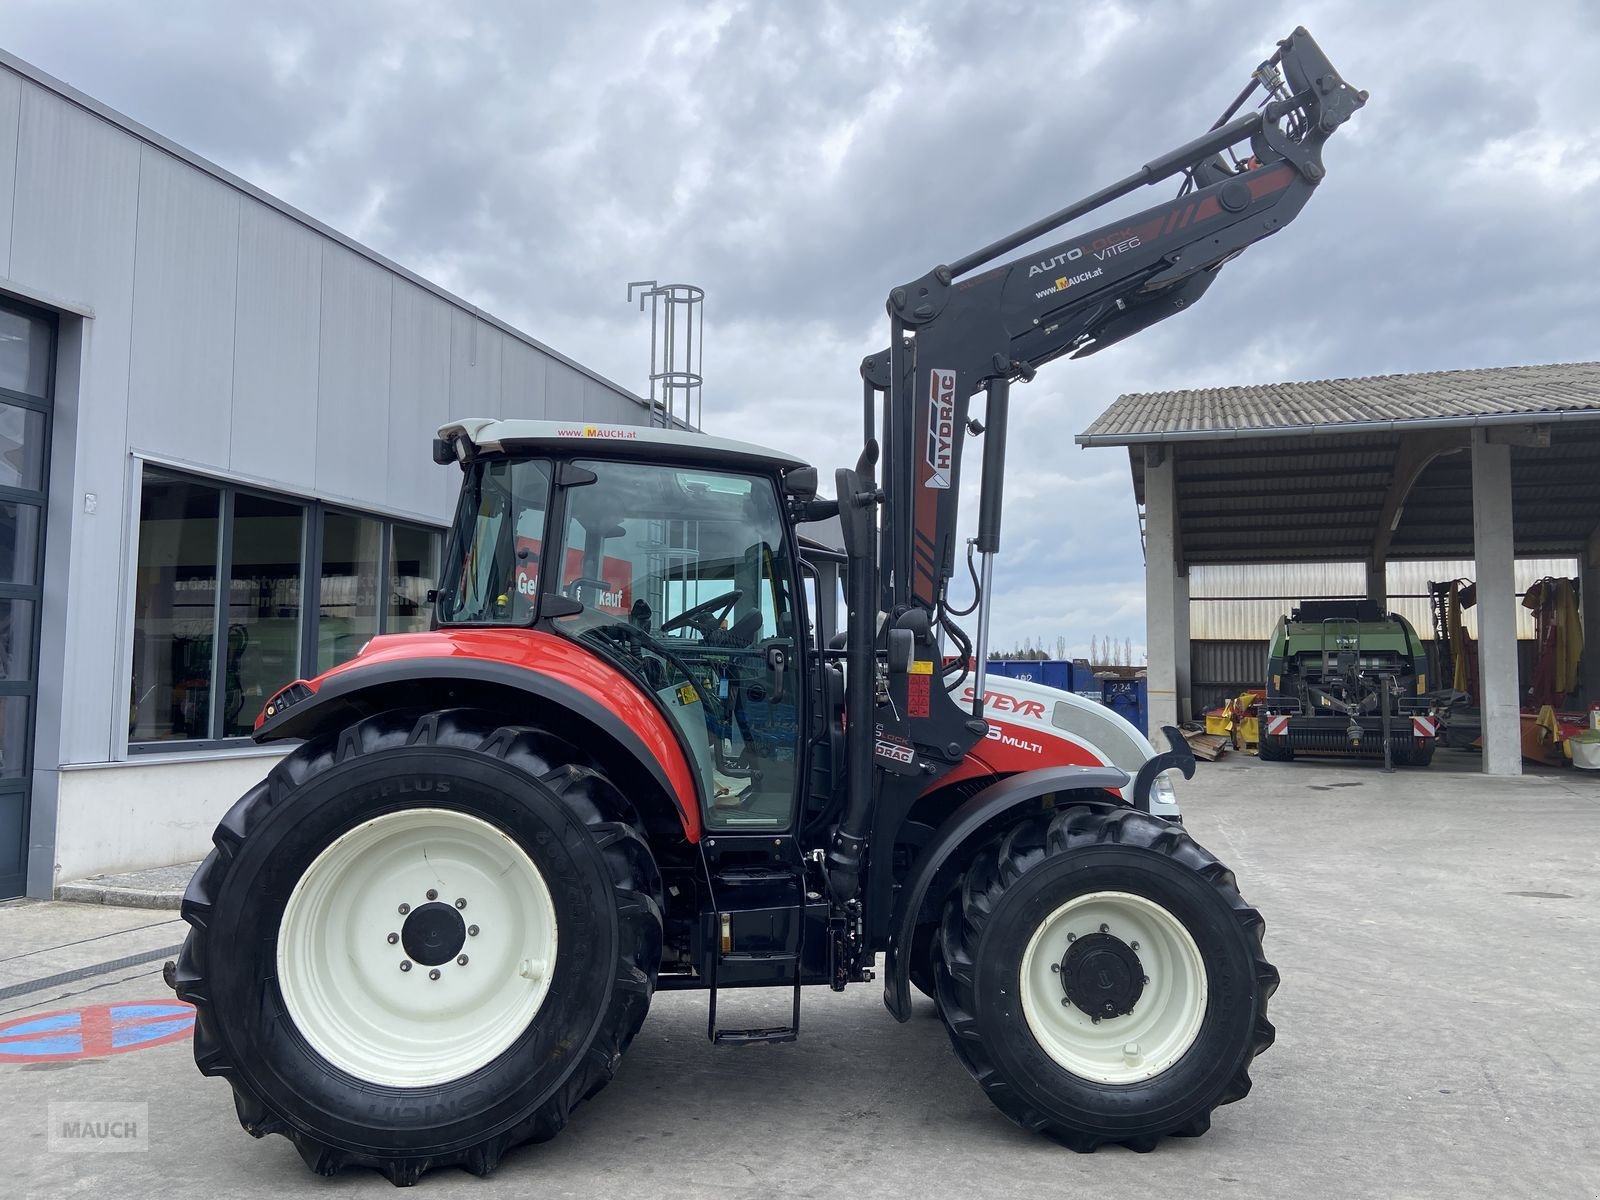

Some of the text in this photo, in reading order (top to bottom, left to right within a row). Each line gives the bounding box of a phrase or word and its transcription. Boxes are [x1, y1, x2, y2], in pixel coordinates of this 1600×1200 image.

[937, 375, 954, 470] HYDRAC
[960, 687, 1046, 719] STEYR
[1001, 735, 1043, 755] MULTI
